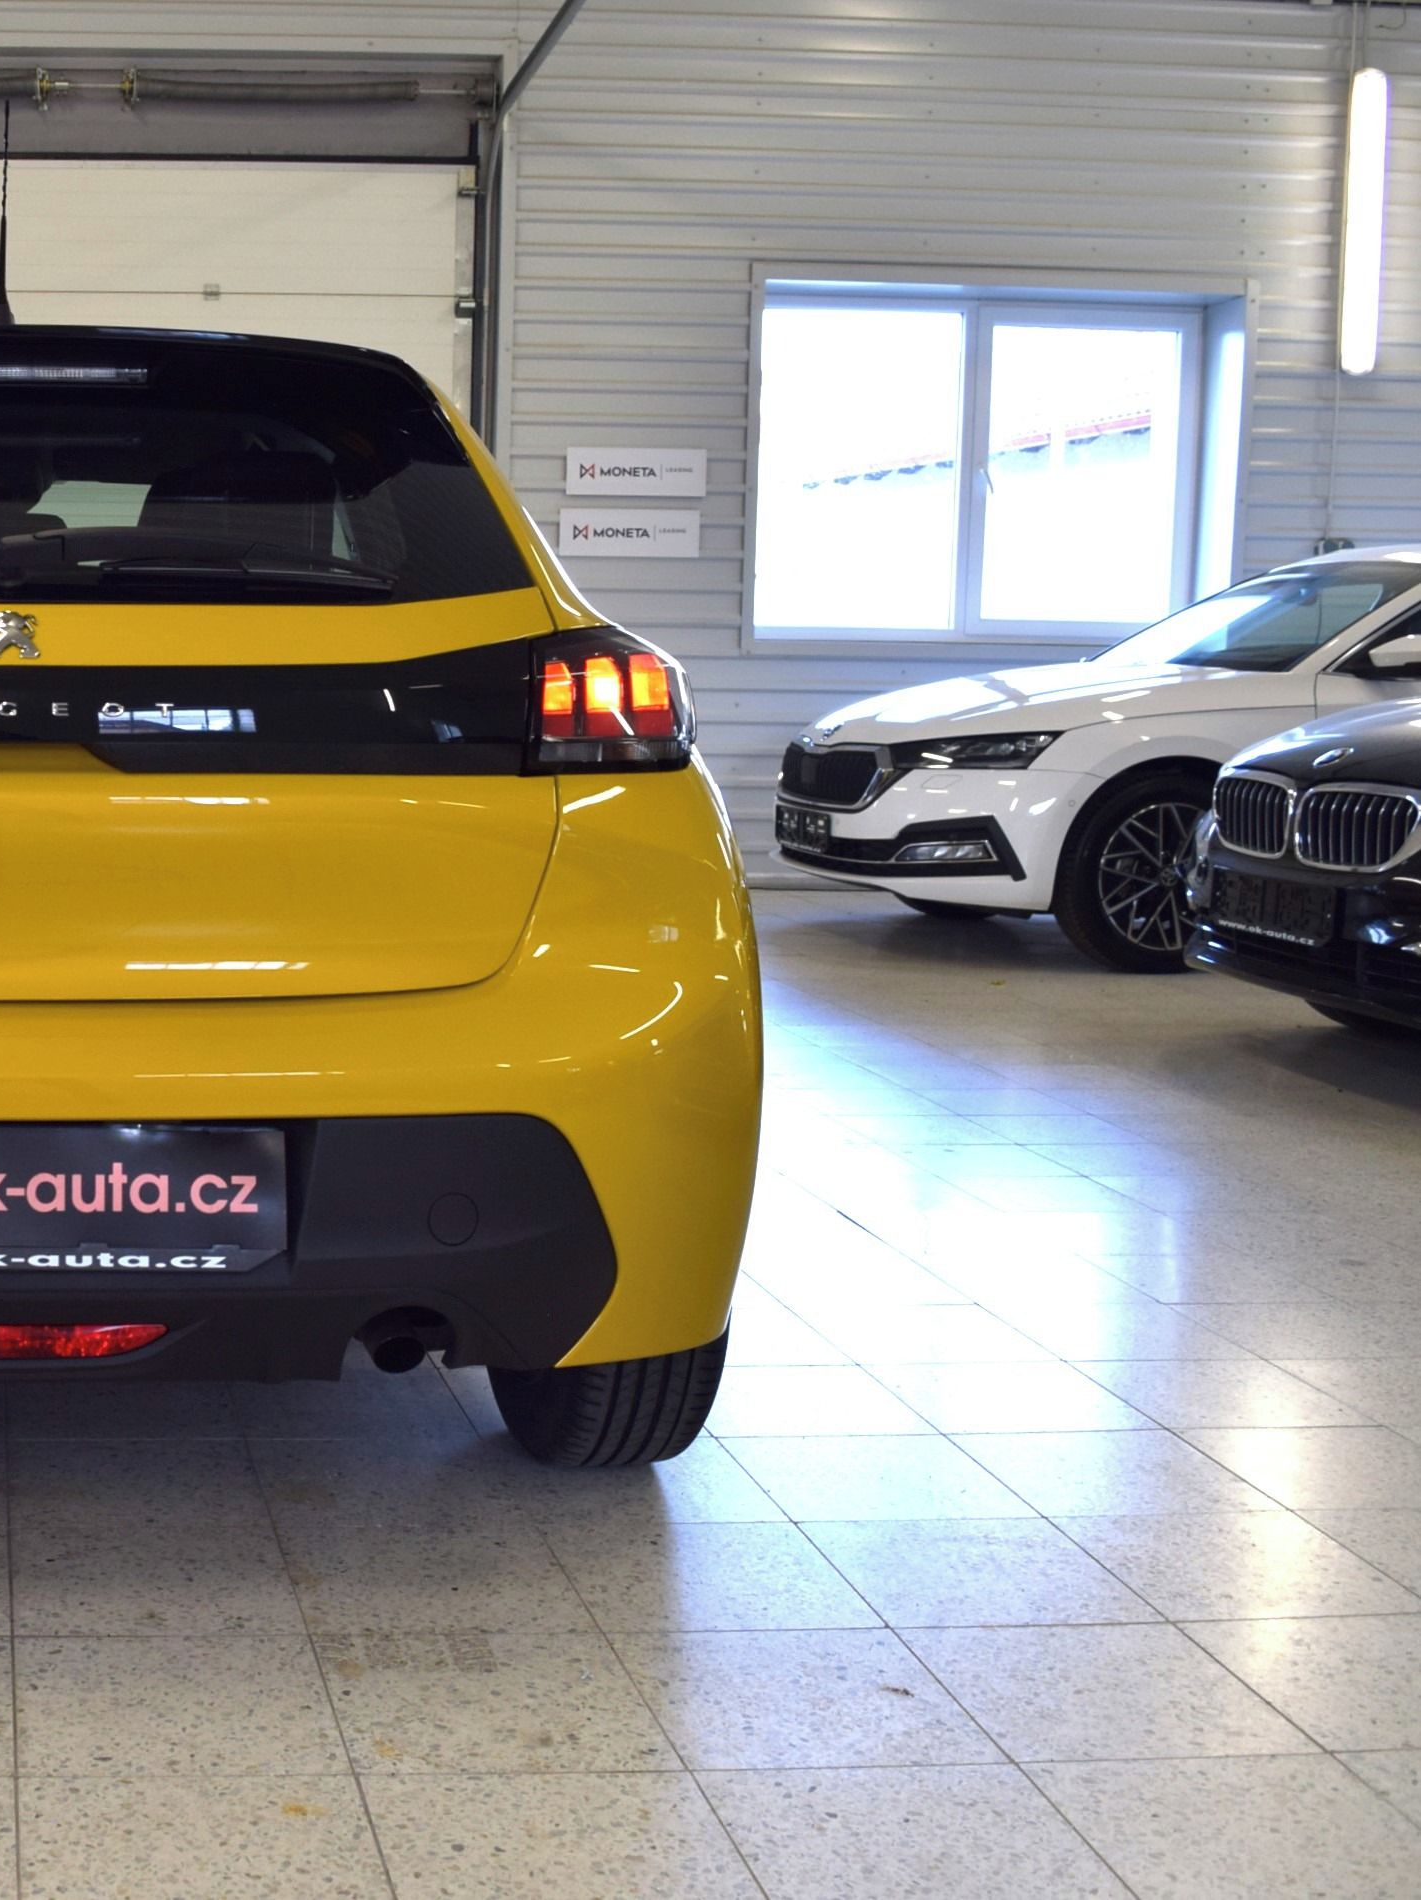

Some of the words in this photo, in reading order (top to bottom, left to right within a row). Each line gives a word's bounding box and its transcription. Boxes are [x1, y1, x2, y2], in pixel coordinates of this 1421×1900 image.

[599, 466, 657, 478] MONETA
[592, 527, 650, 539] MONETA
[1218, 919, 1315, 946] www.ok-auta.cz
